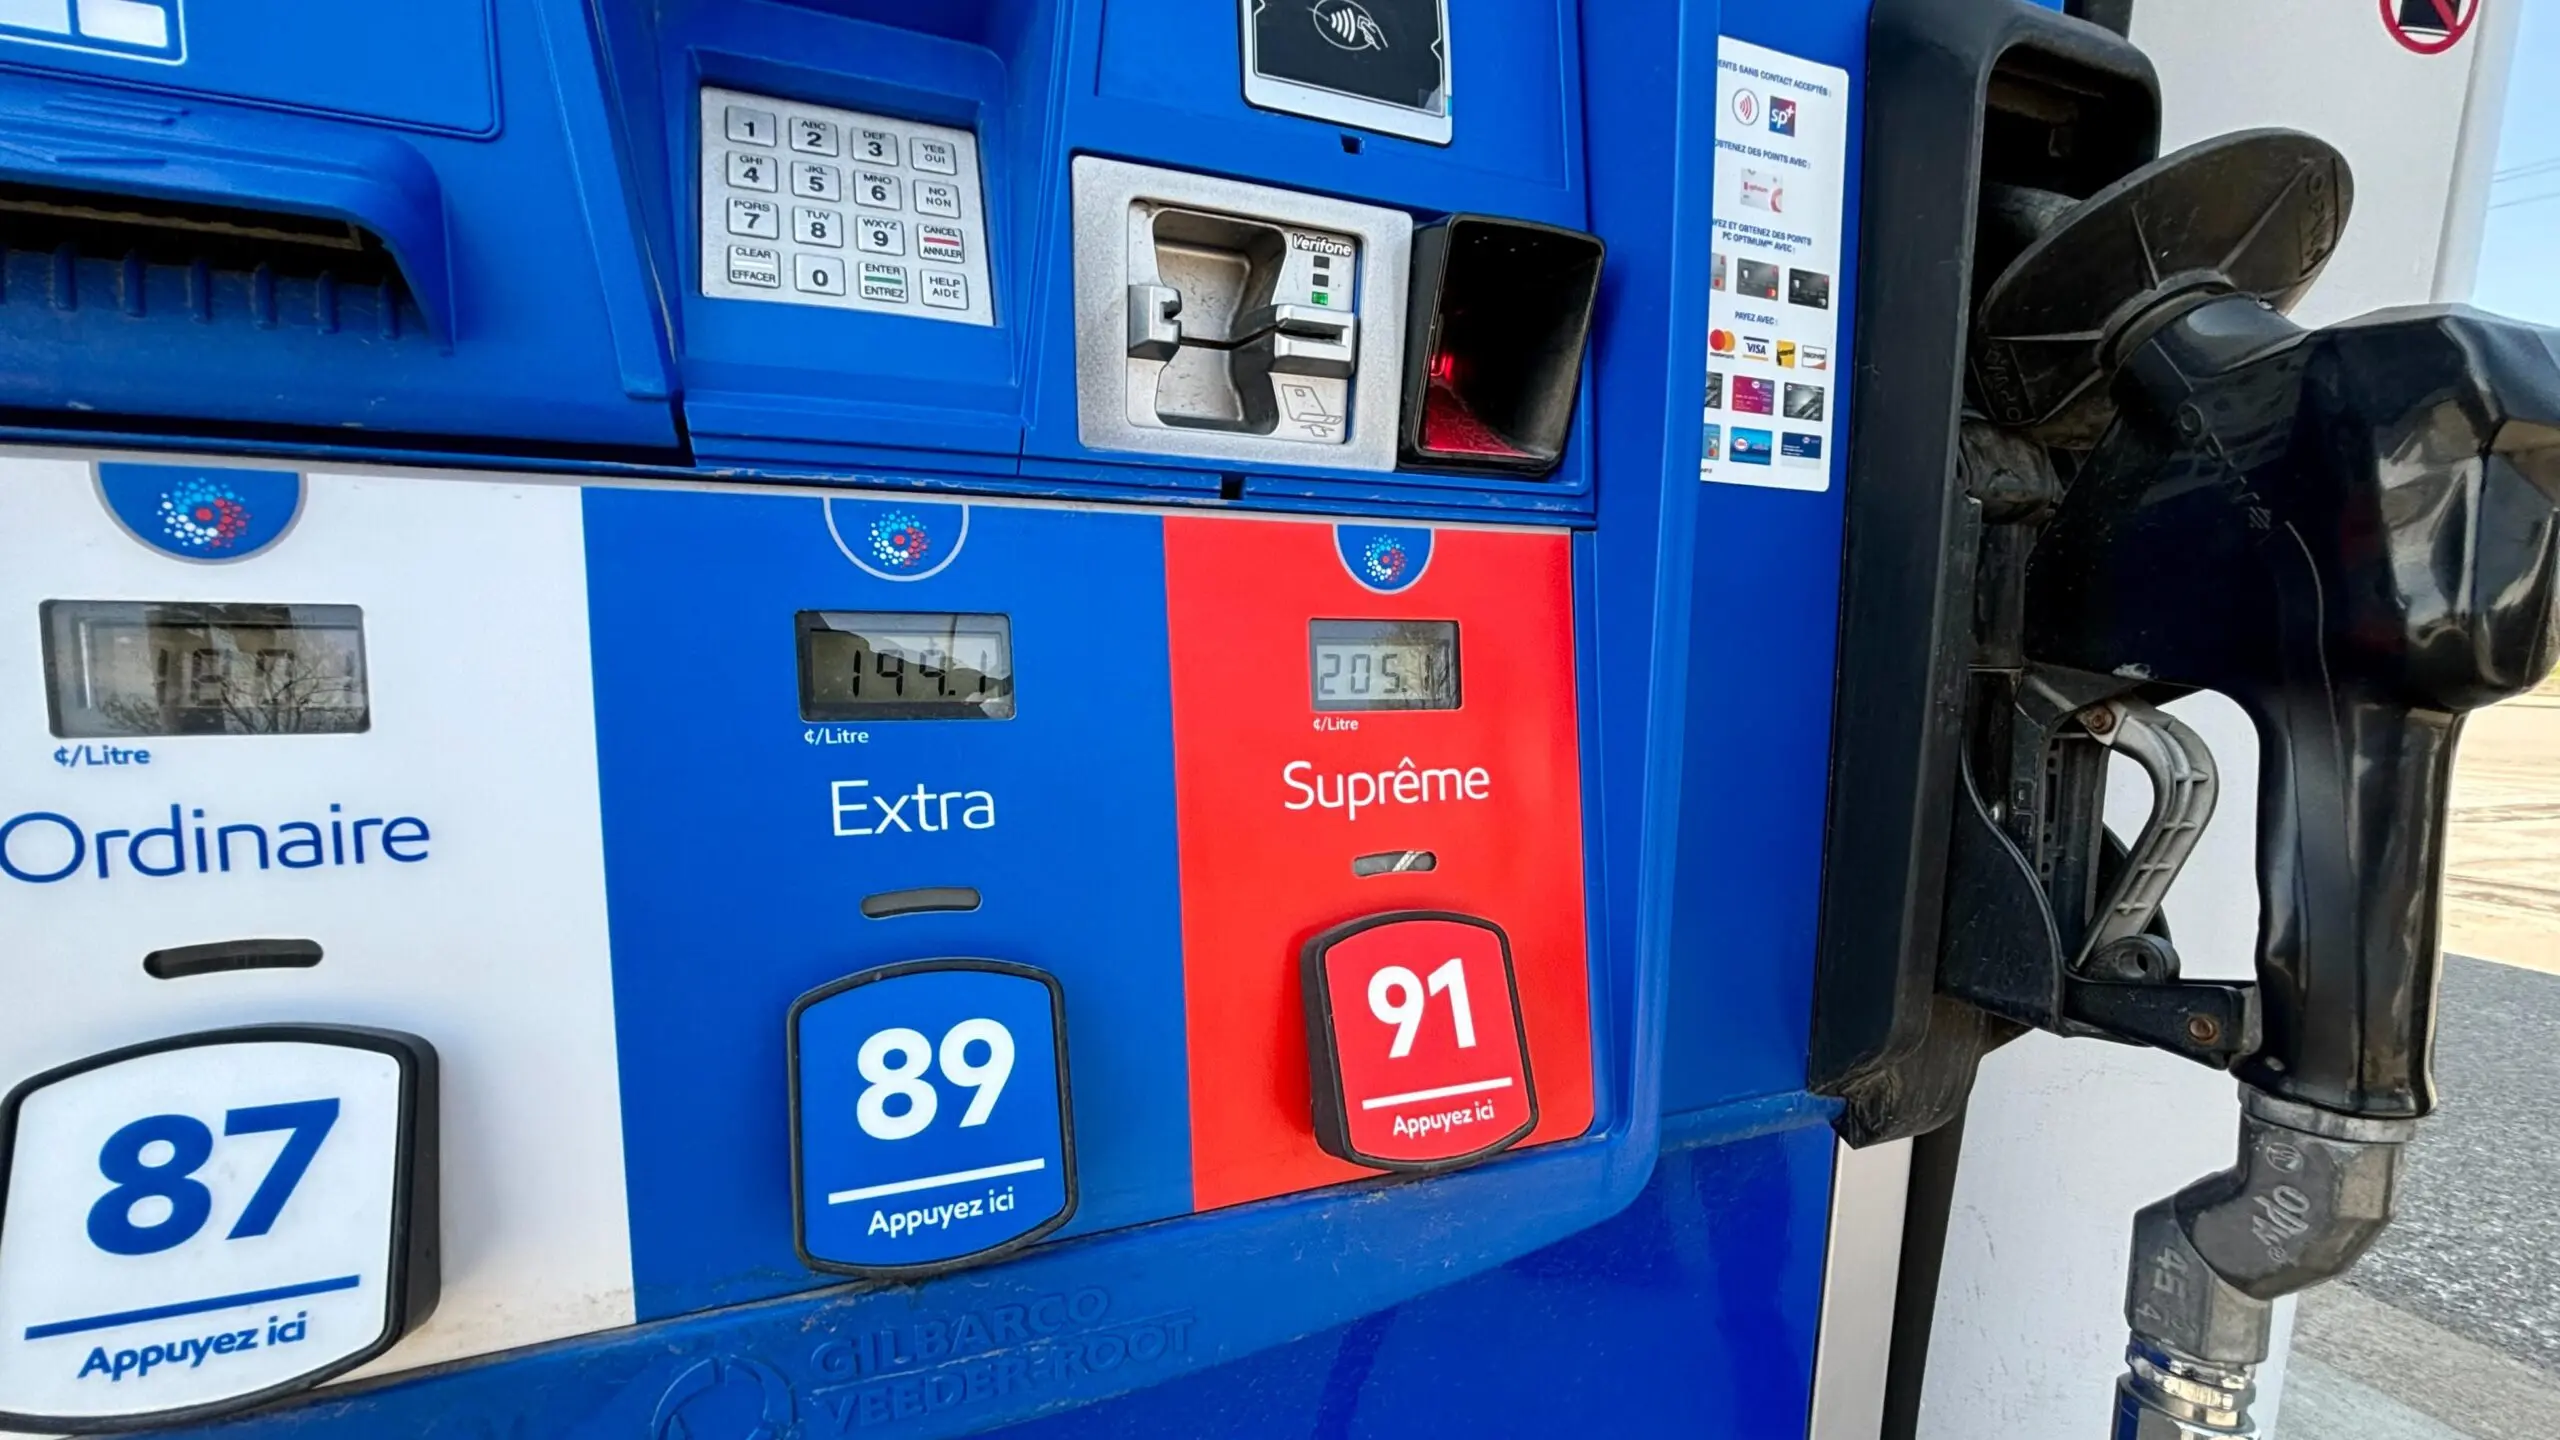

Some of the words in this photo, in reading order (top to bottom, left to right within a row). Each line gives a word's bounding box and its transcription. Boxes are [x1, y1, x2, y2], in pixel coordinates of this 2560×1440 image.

[1739, 64, 1759, 77] SANS
[1761, 70, 1792, 86] CONTACT
[743, 121, 756, 137] 1
[801, 120, 827, 131] ABC
[806, 131, 822, 147] 2
[863, 130, 886, 141] DEF
[868, 141, 883, 157] 3
[922, 143, 945, 155] YES
[1748, 146, 1762, 157] DES
[1763, 150, 1789, 164] POINTS
[1789, 156, 1807, 168] AVEC
[739, 155, 763, 166] GHI
[924, 153, 946, 165] OUI
[743, 167, 760, 183] 4
[804, 165, 827, 176] JKL
[809, 176, 825, 193] 5
[863, 174, 892, 185] MNO
[871, 185, 887, 202] 6
[928, 186, 947, 197] NO
[734, 200, 770, 212] PQRS
[926, 196, 952, 208] NON
[744, 212, 760, 229] 7
[805, 210, 830, 220] TUV
[811, 221, 827, 239] 8
[862, 218, 897, 230] WXYZ
[923, 226, 958, 238] CANCEL
[873, 230, 889, 247] 9
[1728, 221, 1737, 230] ET
[1739, 223, 1770, 237] OBTENEZ
[1772, 230, 1785, 241] DES
[1787, 233, 1812, 246] POINTS
[1292, 235, 1351, 256] Verifone
[1722, 231, 1732, 241] PC
[1774, 241, 1792, 253] AVEC
[735, 247, 771, 260] CLEAR
[922, 246, 963, 259] ANNULER
[731, 270, 776, 283] EFFACER
[865, 264, 900, 275] ENTER
[812, 269, 828, 287] 0
[929, 276, 961, 288] HELP
[864, 286, 904, 298] ENTREZ
[931, 287, 960, 299] AIDE
[1734, 311, 1756, 323] PAYEZ
[1756, 315, 1775, 325] AVEC
[1746, 342, 1766, 355] VISA
[1319, 653, 1432, 695] 205.1
[1313, 716, 1359, 732] ¢/Litre
[804, 727, 869, 746] ¢/Litre
[53, 745, 150, 767] ¢/Litre
[1283, 756, 1491, 821] Suprême
[831, 780, 996, 837] Extra
[0, 803, 430, 883] Ordinaire
[1367, 957, 1477, 1059] 91
[856, 1017, 1016, 1141] 89
[1392, 1108, 1473, 1140] Appuyez
[1474, 1099, 1495, 1121] ici
[86, 1097, 341, 1256] 87
[867, 1200, 983, 1239] Appuyez
[988, 1185, 1015, 1213] ici
[811, 1284, 1113, 1382] GILBARCO
[77, 1325, 260, 1381] Appuyez
[267, 1311, 308, 1346] ici
[825, 1315, 1197, 1432] VEEDER-ROOT
